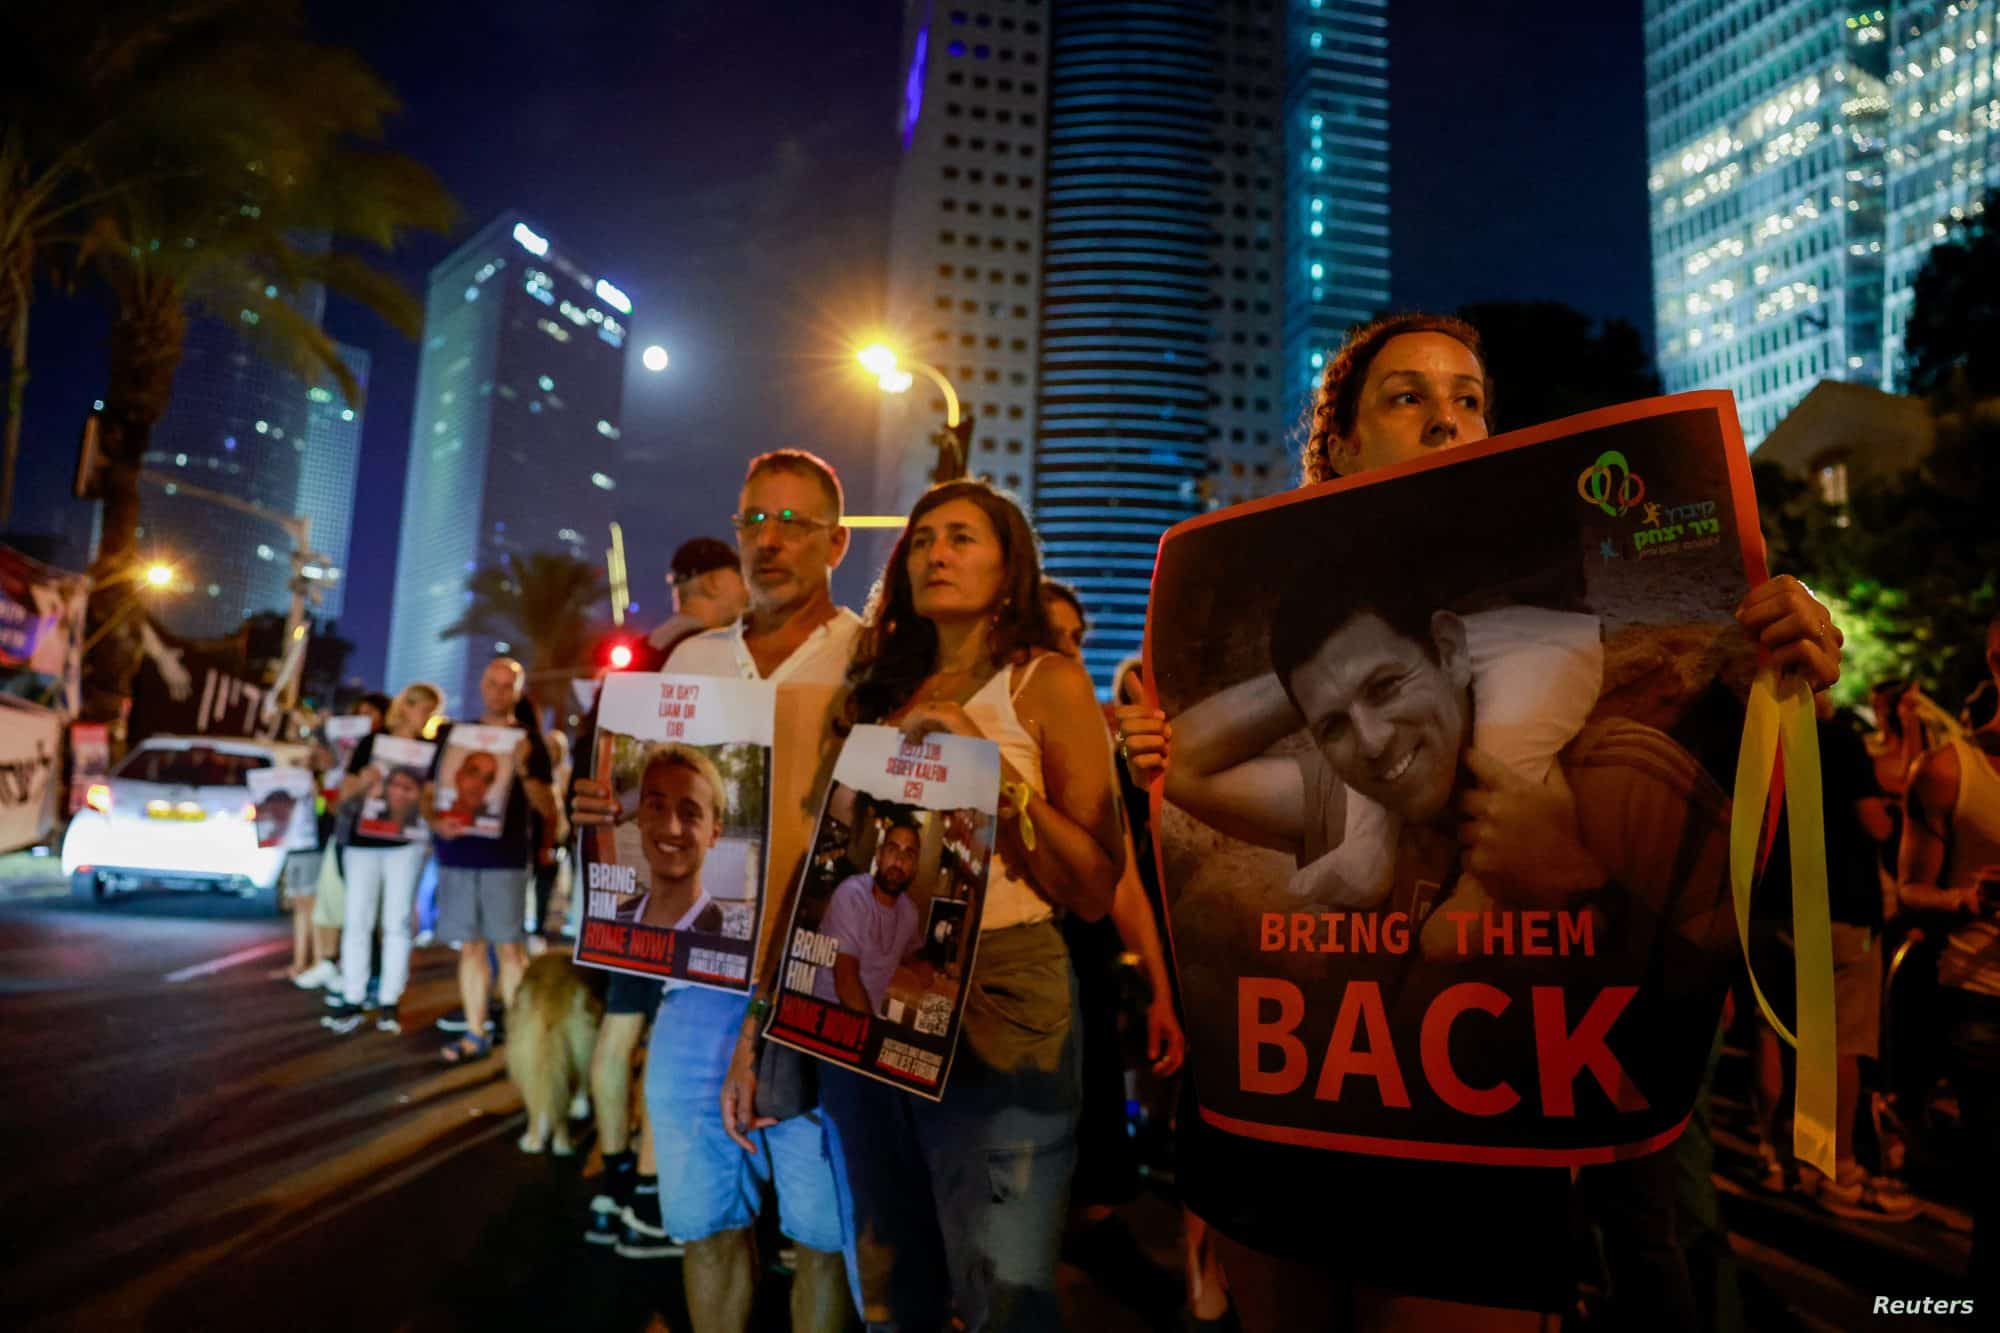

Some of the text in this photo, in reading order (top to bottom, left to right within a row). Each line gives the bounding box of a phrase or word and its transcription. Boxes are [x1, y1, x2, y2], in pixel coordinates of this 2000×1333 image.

[1633, 524, 1685, 552] יצחק
[1688, 517, 1719, 537] ניר
[588, 862, 637, 894] BRING
[588, 890, 617, 921] HIM
[583, 920, 629, 955] HOME
[630, 928, 676, 964] NOW!
[791, 927, 839, 968] BRING
[1260, 911, 1595, 957] BRING THEM
[784, 958, 817, 995] HIM
[1238, 976, 1650, 1117] BACK
